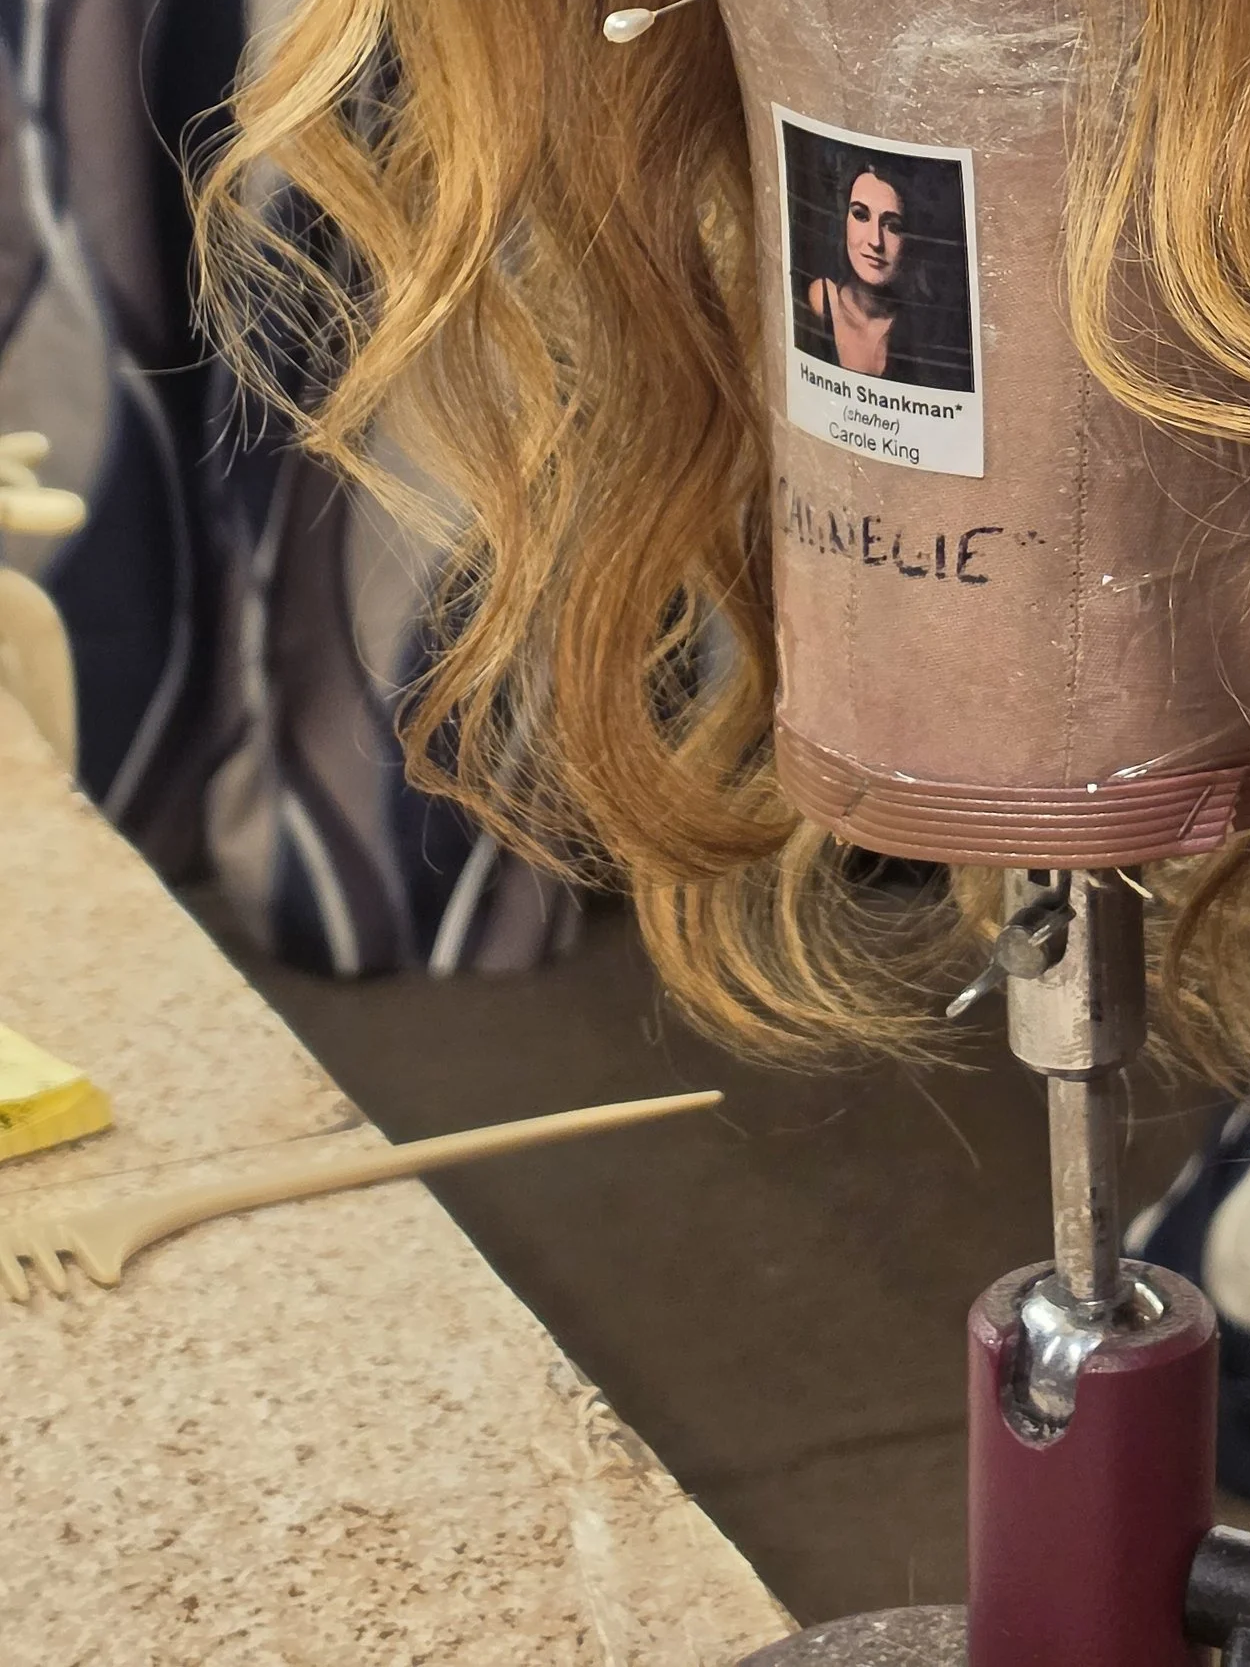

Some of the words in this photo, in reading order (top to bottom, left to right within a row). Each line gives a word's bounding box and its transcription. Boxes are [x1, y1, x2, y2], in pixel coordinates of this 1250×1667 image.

[800, 362, 852, 399] Hannah
[843, 405, 901, 436] (she/her)
[828, 421, 877, 452] Carole
[882, 437, 921, 465] King
